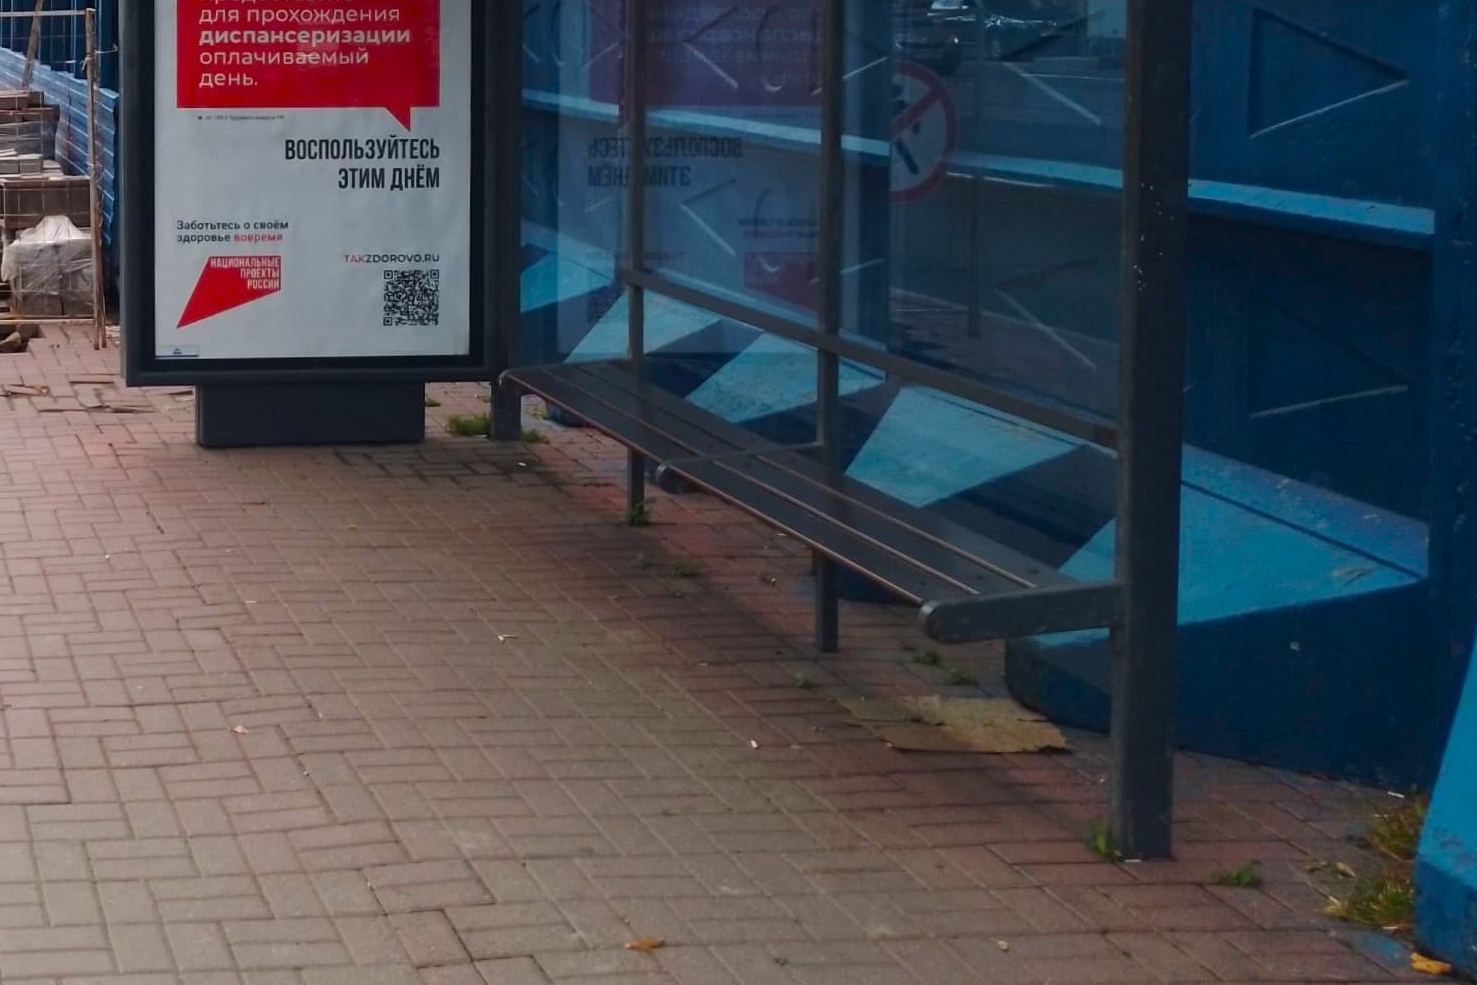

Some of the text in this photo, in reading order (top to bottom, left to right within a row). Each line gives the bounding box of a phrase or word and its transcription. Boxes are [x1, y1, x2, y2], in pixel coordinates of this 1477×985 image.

[199, 8, 400, 25] для прохождения
[199, 29, 410, 47] диспансеризации
[200, 48, 369, 65] оплачиваемый
[199, 72, 258, 87] день.
[285, 135, 440, 160] ВОСПОЛЬЗУЙТЕСЬ
[338, 166, 440, 191] ЭТИМ ДНЁМ
[177, 220, 289, 230] Заботьтесь о своём
[177, 234, 283, 244] здоровье вовремя
[210, 257, 280, 268] НАЦИОНАЛЬНЫЕ
[344, 254, 440, 263] TAKZDOROVO.RU
[240, 268, 280, 279] ПРОЕКТЫ
[246, 278, 280, 289] РОССИИ
